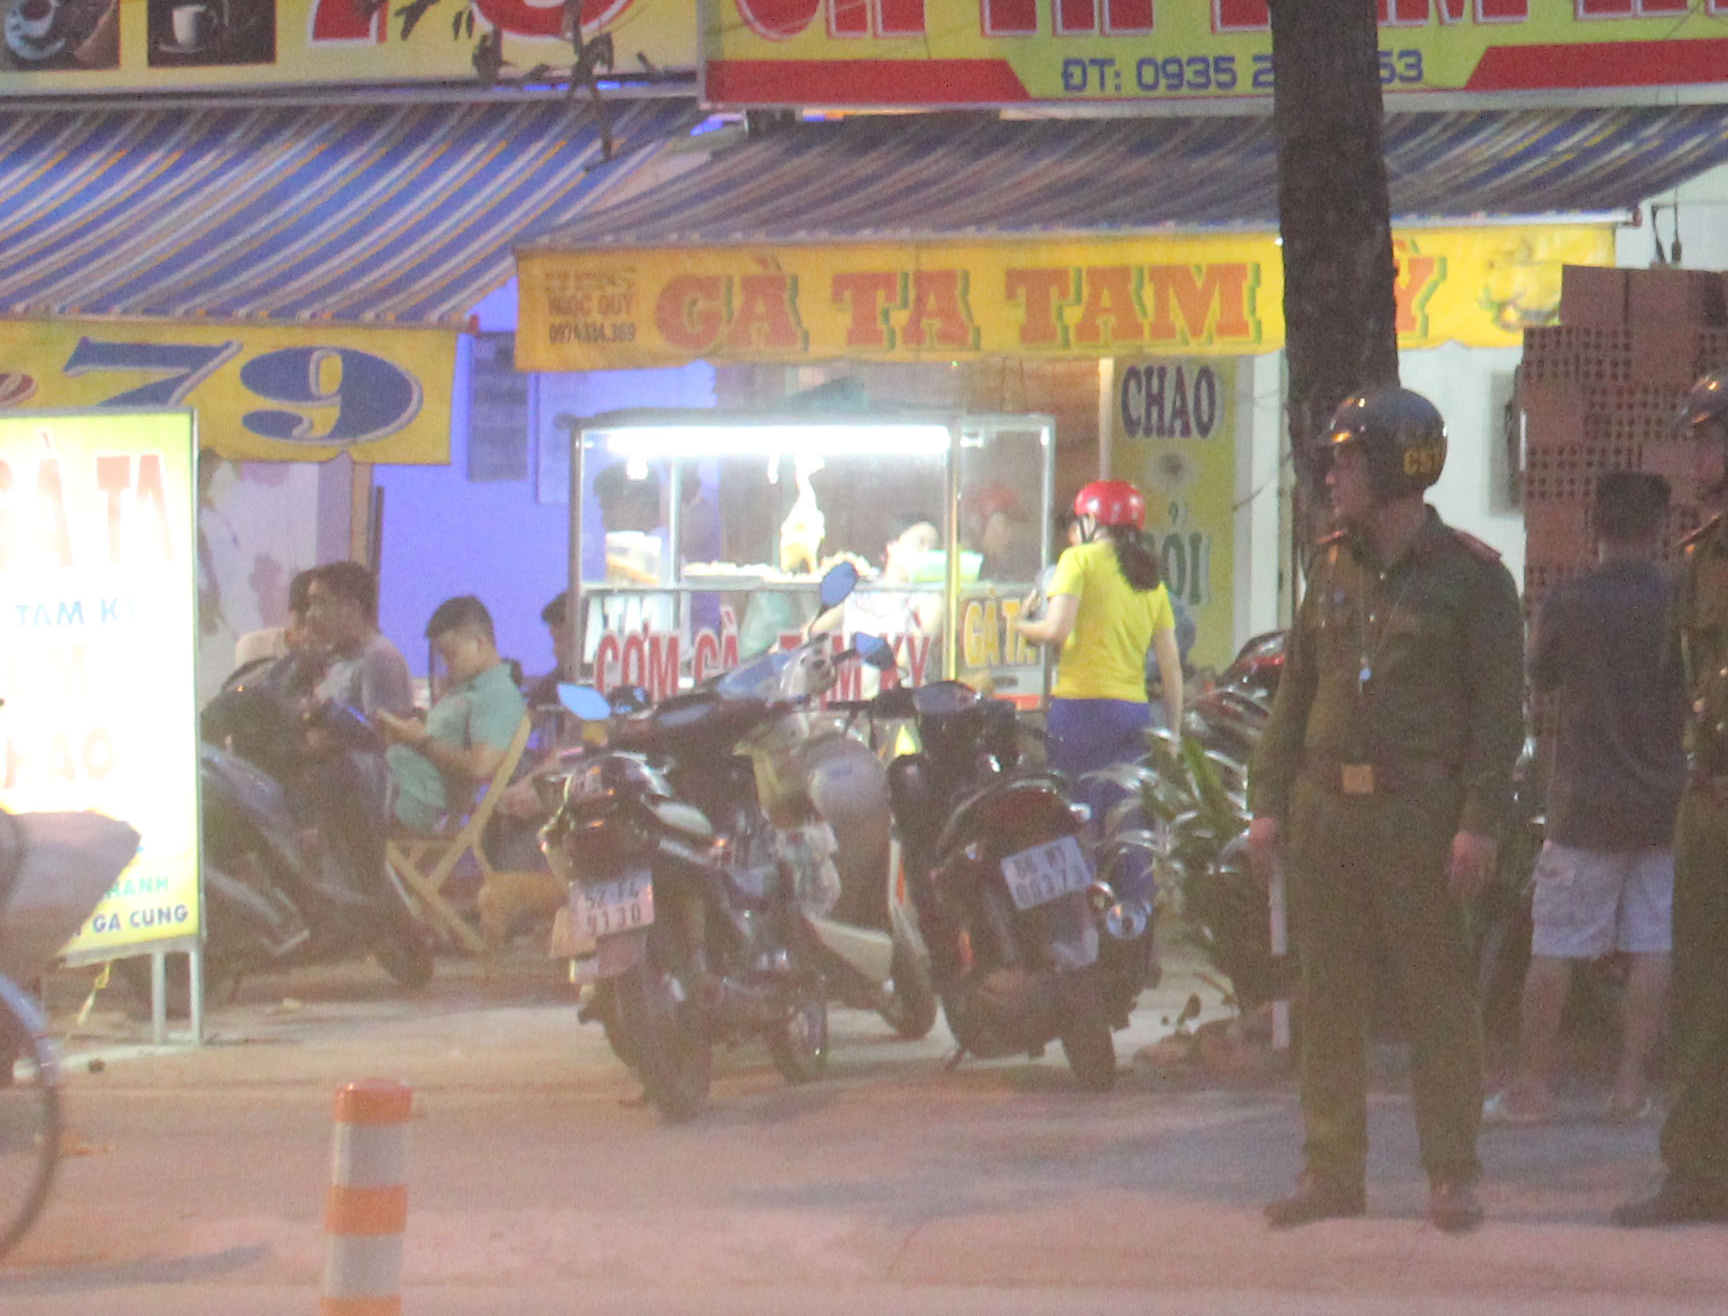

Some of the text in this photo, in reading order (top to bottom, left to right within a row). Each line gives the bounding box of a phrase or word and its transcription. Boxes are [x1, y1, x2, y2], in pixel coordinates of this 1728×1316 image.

[1135, 54, 1238, 91] 0935
[654, 257, 811, 352] GÀ
[831, 268, 982, 351] TA
[1004, 261, 1264, 348] TAM
